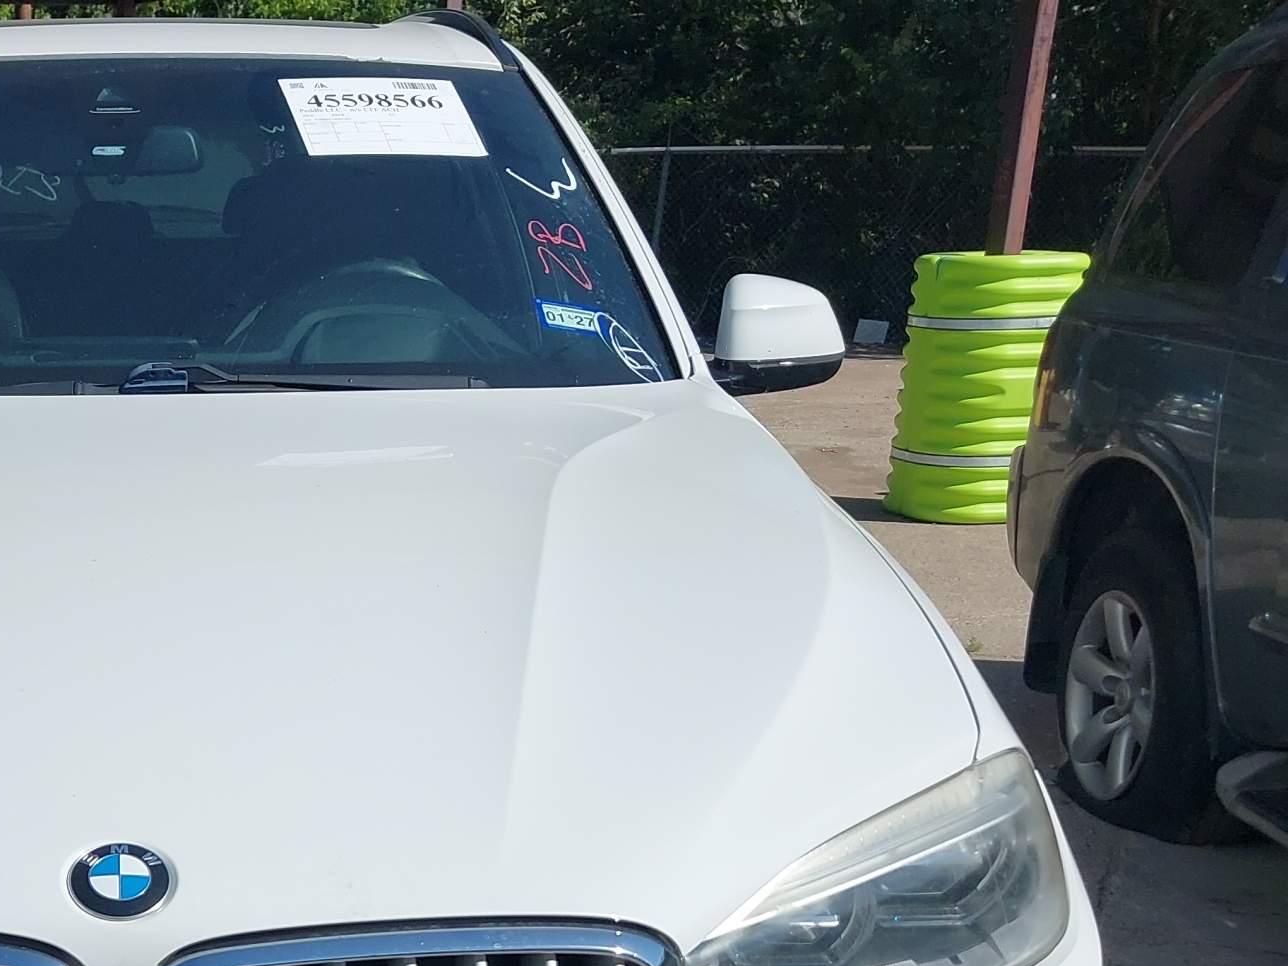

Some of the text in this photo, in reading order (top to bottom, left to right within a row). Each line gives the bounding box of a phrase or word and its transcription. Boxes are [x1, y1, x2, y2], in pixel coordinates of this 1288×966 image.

[307, 93, 443, 110] 45598566
[546, 310, 594, 328] 01 27
[80, 844, 162, 867] BMW
